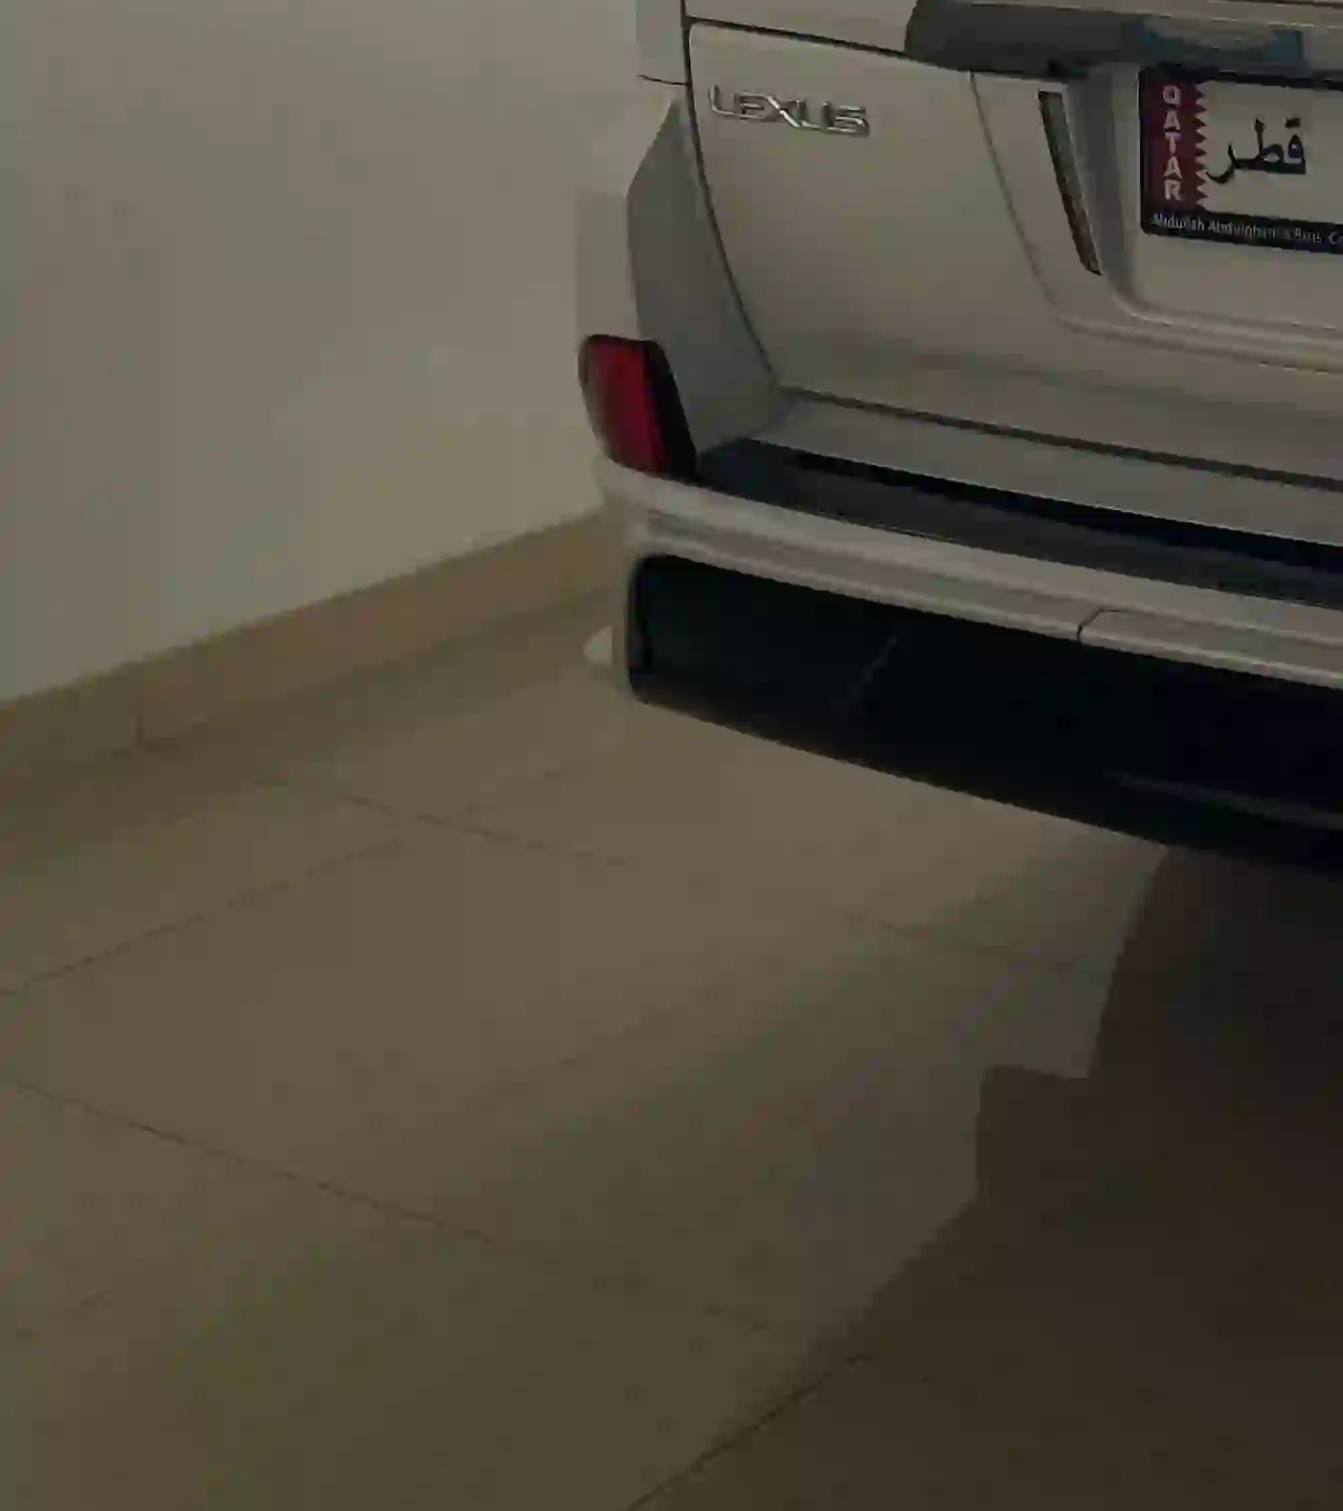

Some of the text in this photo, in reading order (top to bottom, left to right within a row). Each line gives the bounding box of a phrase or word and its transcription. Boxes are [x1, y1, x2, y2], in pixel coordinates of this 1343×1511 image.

[708, 85, 870, 138] LEXUS
[1162, 84, 1183, 201] QATAR
[1204, 116, 1306, 184] قطر
